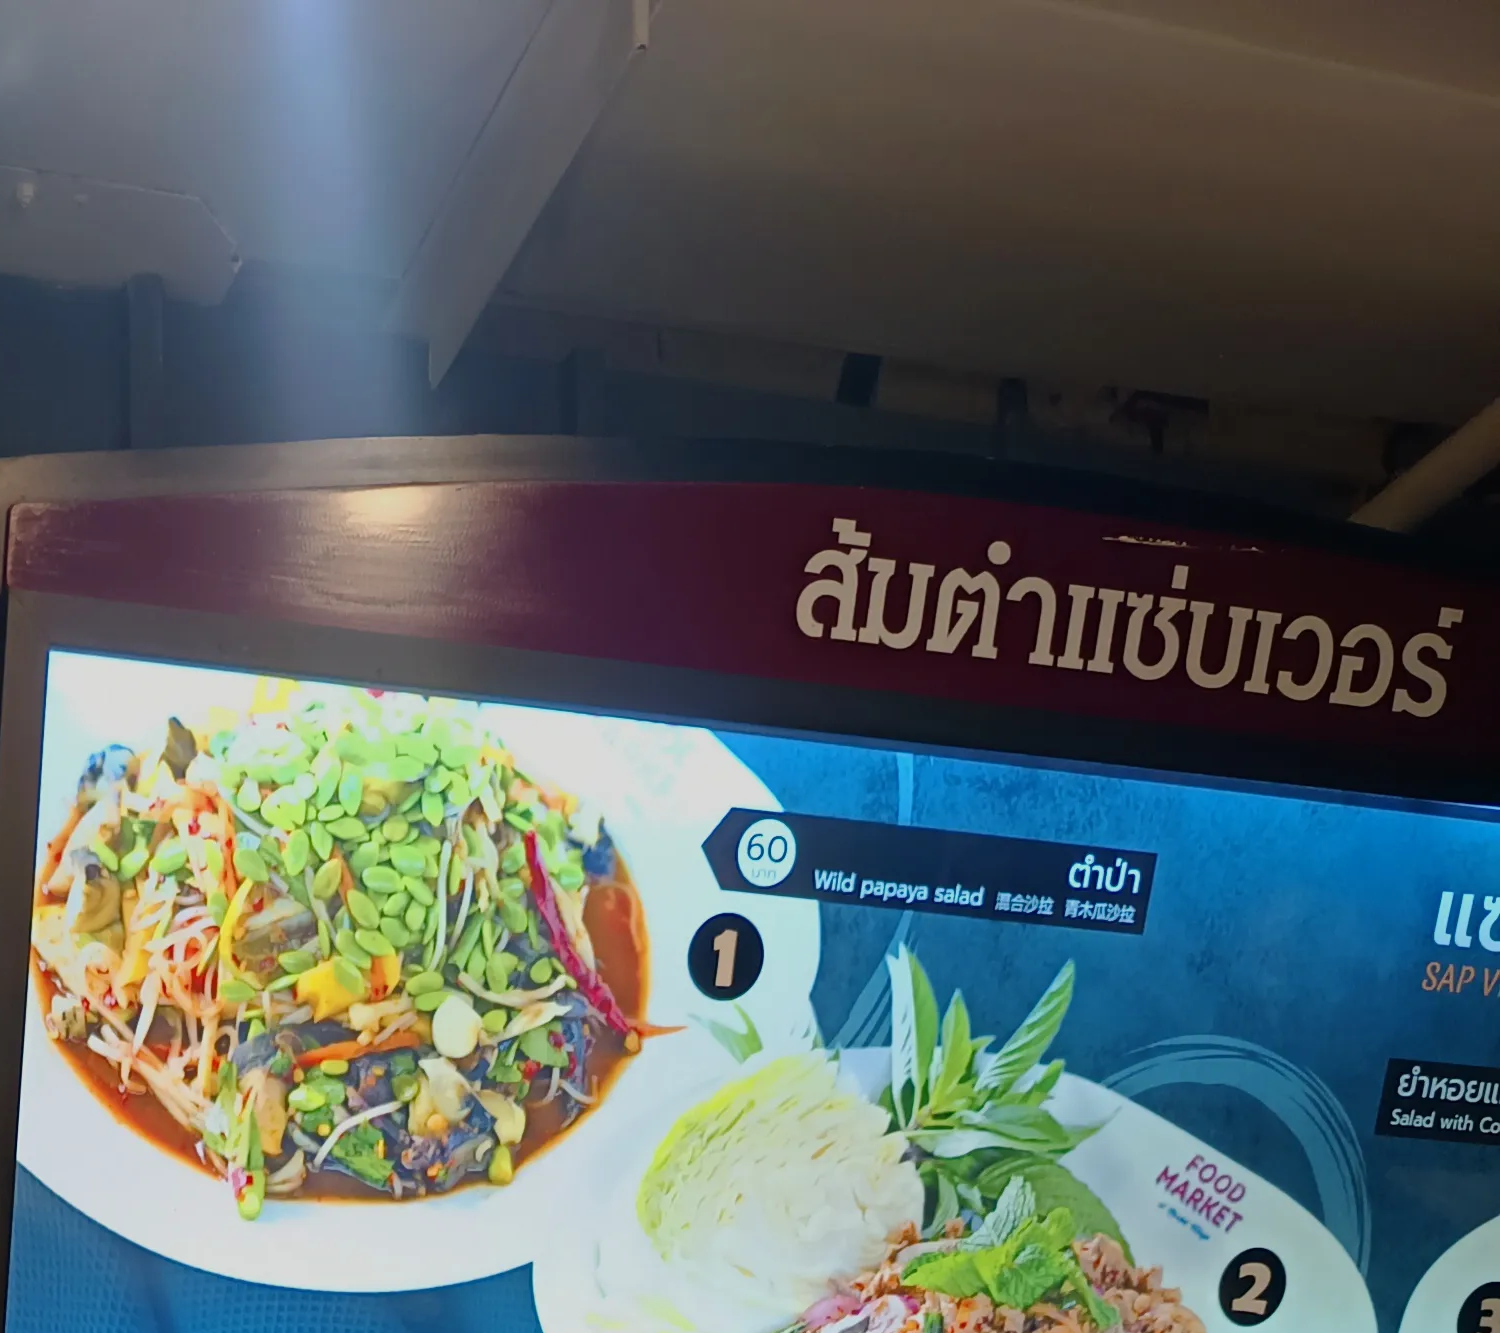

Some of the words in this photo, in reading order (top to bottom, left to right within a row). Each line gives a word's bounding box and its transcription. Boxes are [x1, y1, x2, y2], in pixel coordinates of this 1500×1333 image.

[795, 517, 1463, 718] ส้มตำแซ่บเวอร์
[746, 833, 788, 863] 60
[814, 869, 856, 894] Wild
[861, 876, 929, 904] papaya
[934, 882, 984, 907] salad
[1068, 853, 1142, 894] ตำป่า
[713, 929, 738, 988] 1
[1422, 961, 1475, 993] SAP
[1483, 968, 1500, 998] V
[1397, 1065, 1500, 1105] ยำหอยแ
[1390, 1108, 1436, 1128] Salad
[1440, 1114, 1474, 1132] with
[1156, 1165, 1244, 1233] MARKET
[1186, 1154, 1246, 1203] FOOD
[1231, 1263, 1273, 1316] 2
